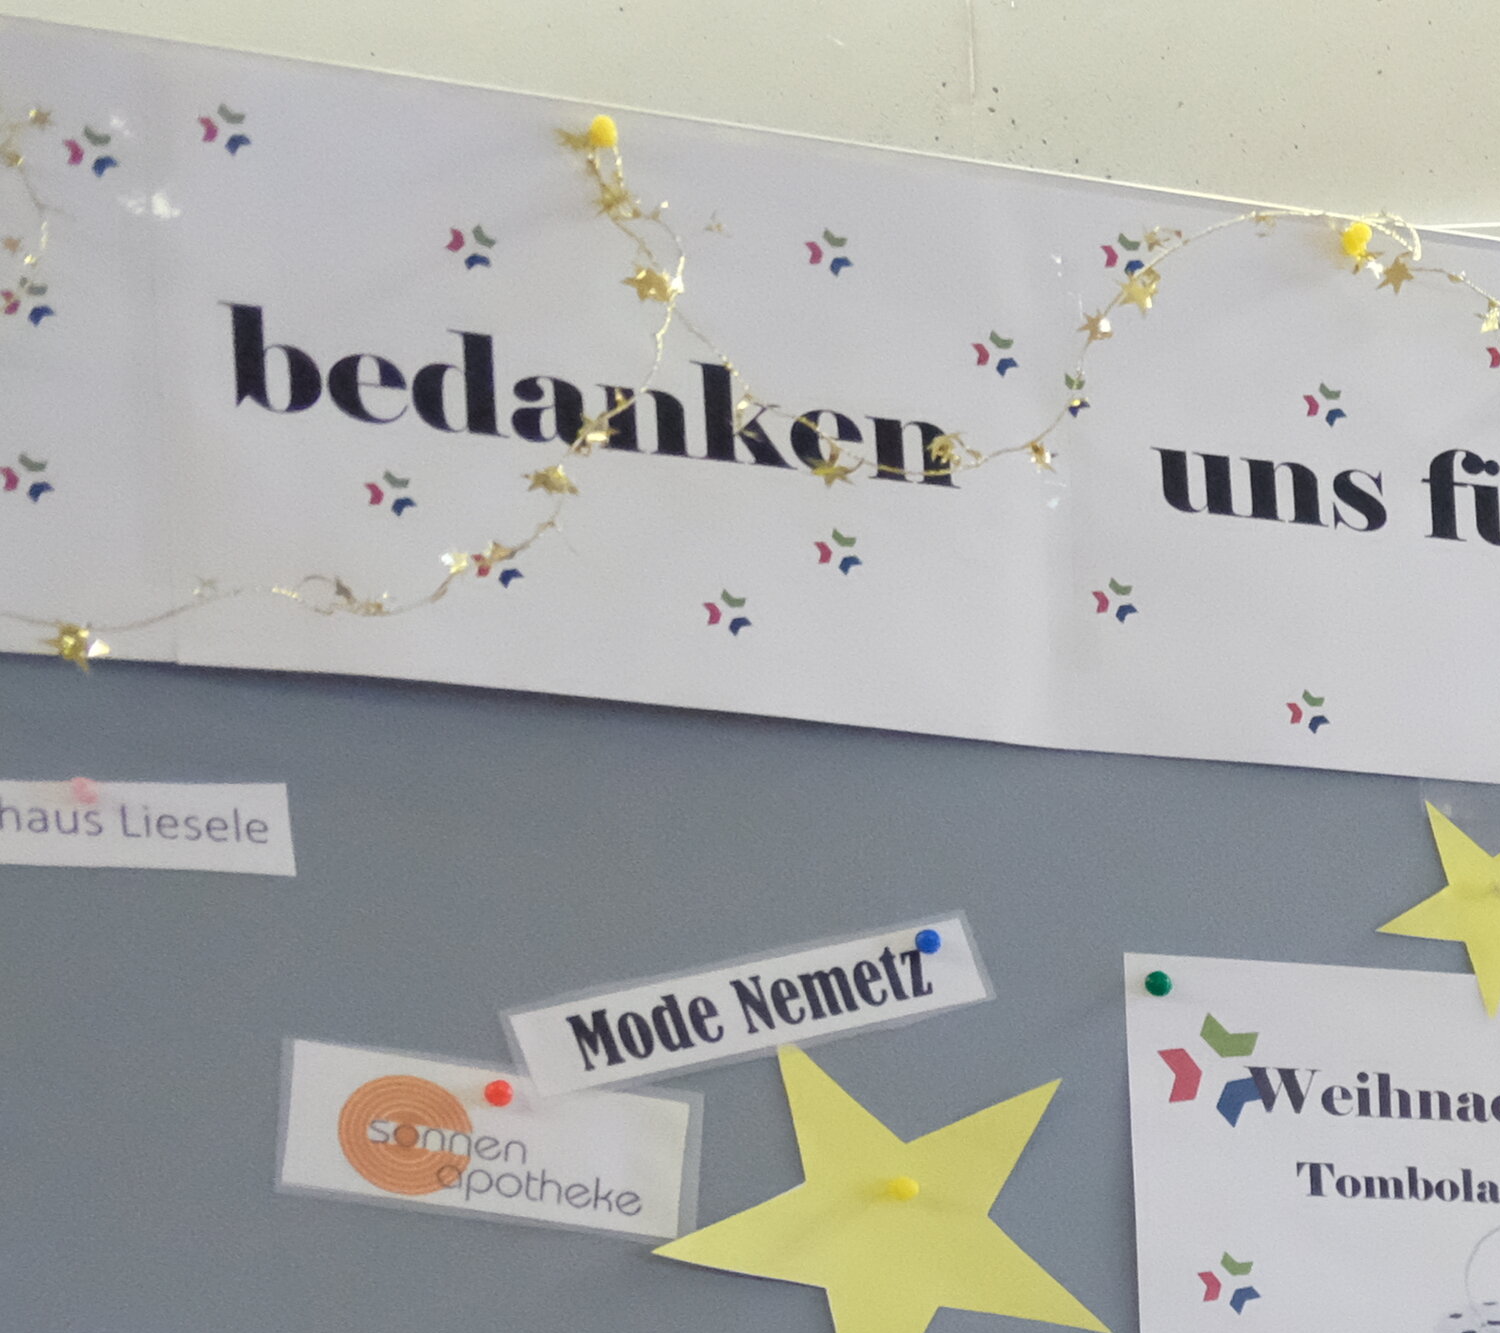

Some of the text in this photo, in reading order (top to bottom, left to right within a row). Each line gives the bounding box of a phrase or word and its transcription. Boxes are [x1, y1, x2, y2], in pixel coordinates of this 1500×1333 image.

[217, 300, 962, 490] bedanken
[1150, 445, 1389, 533] uns
[120, 804, 269, 844] Liesele
[566, 946, 934, 1071] Mode Nemetz
[368, 1119, 528, 1165] sonnen
[437, 1163, 643, 1217] apotheke
[1296, 1161, 1500, 1205] Tombola
